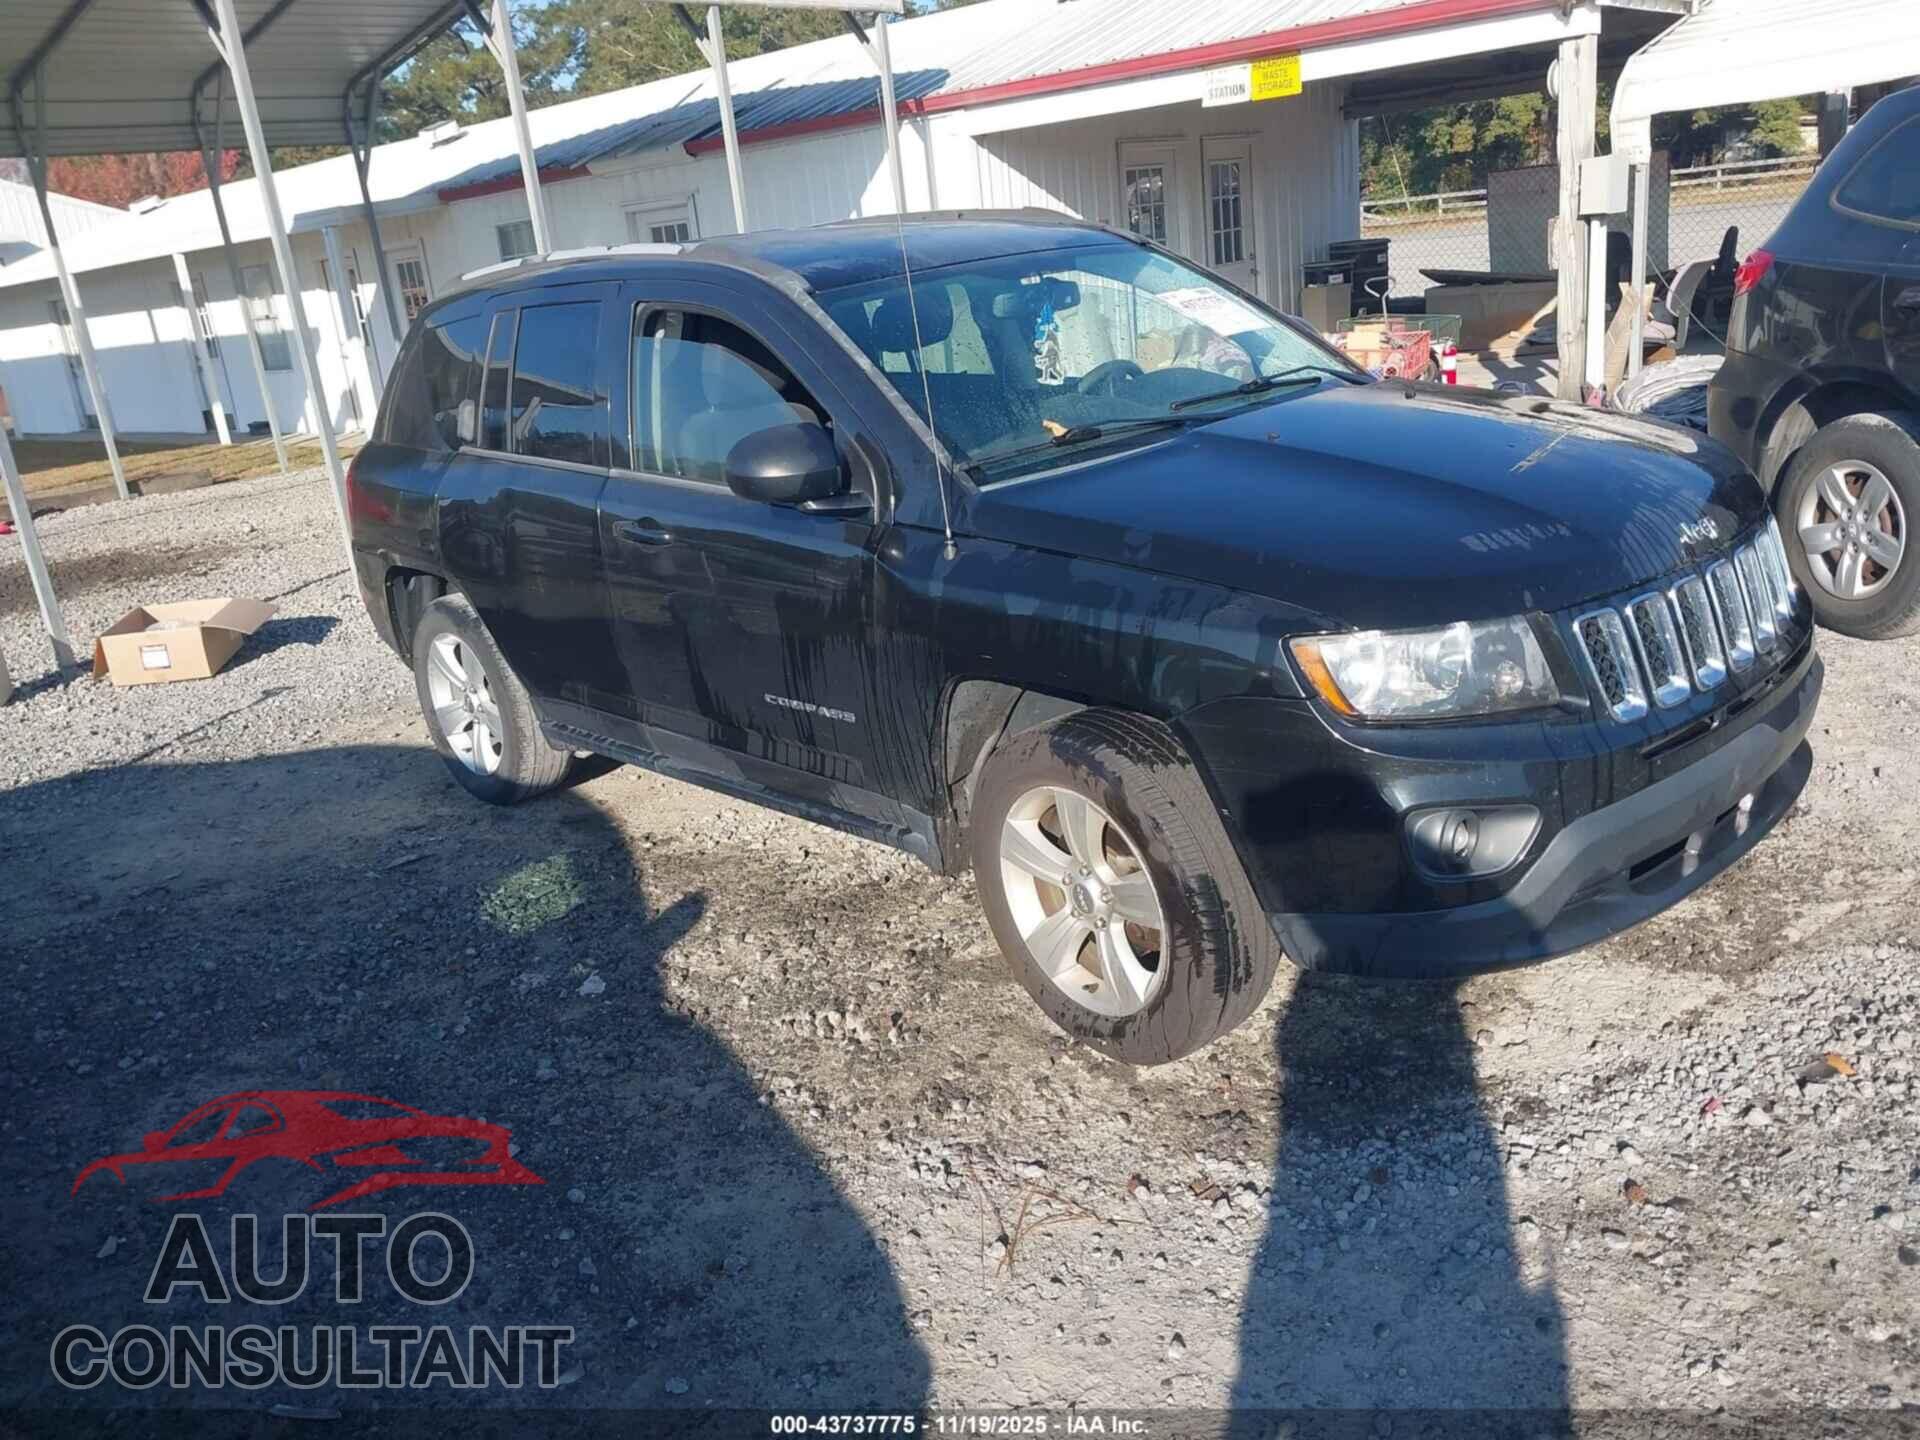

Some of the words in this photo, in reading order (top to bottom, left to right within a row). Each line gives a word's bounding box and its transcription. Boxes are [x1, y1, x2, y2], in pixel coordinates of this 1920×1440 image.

[1262, 68, 1289, 81] WASTE
[1208, 83, 1246, 101] STATION
[1258, 78, 1293, 93] STORAGE
[764, 693, 856, 724] COMPASS
